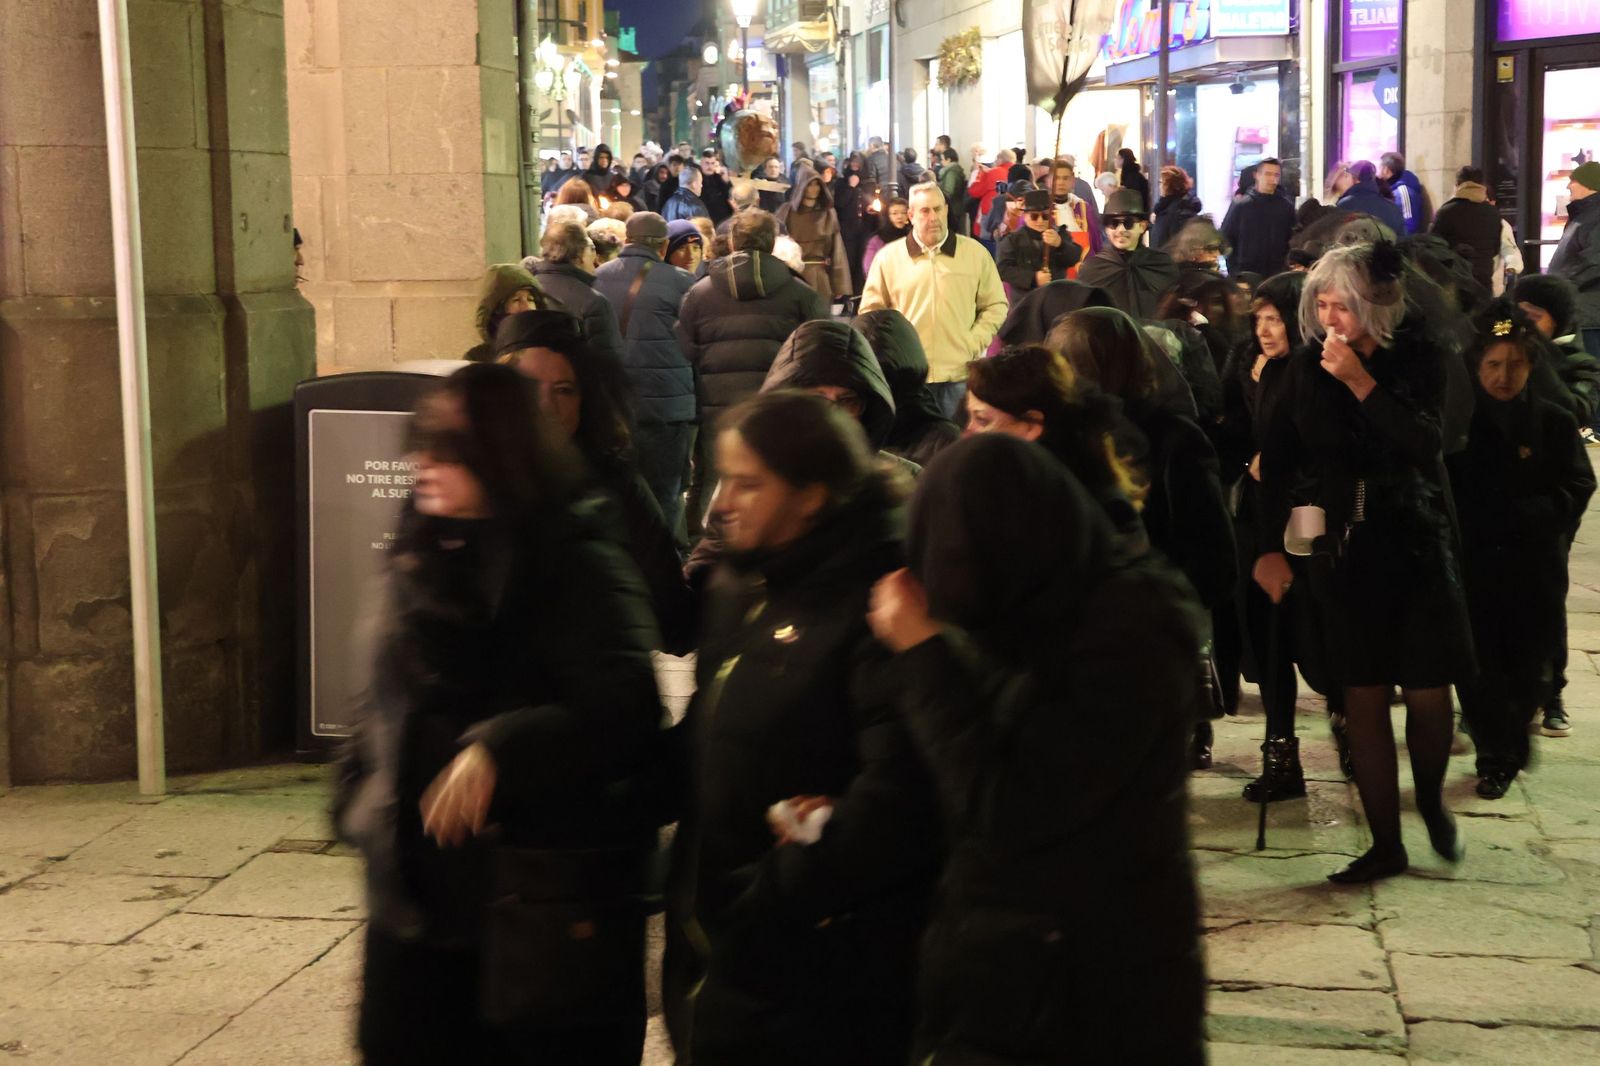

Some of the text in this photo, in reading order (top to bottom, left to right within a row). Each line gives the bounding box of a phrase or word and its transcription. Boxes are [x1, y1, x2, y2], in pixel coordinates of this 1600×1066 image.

[364, 461, 420, 471] POR FAVO
[346, 474, 416, 485] NO TIRE RESI
[371, 488, 386, 497] AL
